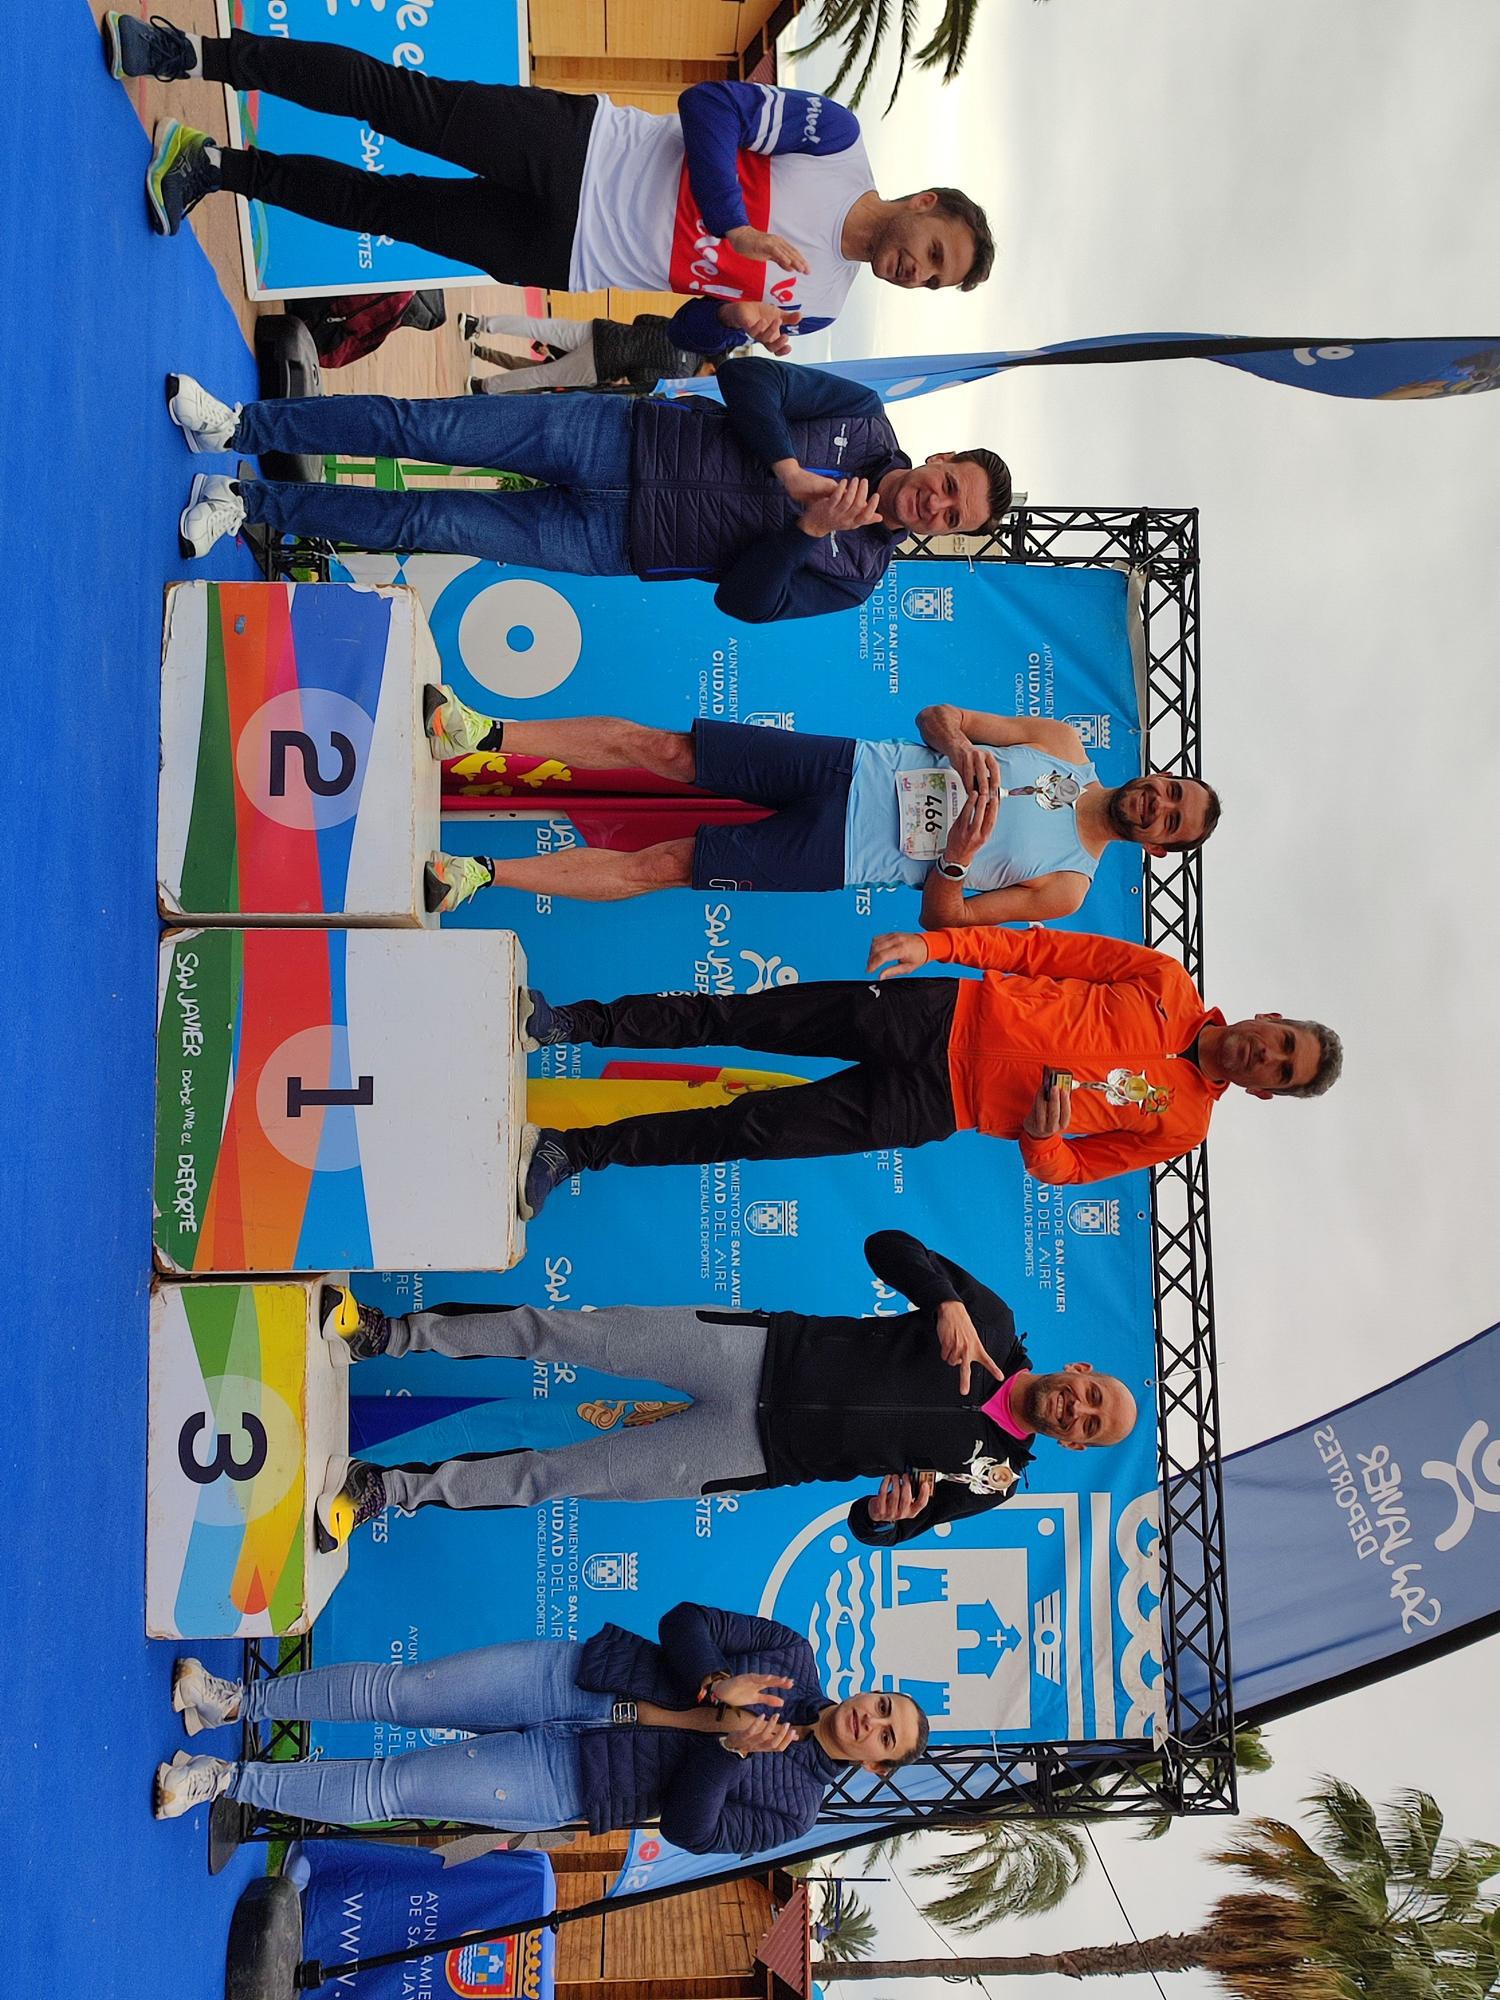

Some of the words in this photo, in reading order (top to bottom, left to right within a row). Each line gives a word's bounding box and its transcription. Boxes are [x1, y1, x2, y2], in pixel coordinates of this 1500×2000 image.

[872, 595, 884, 625] DEL
[888, 605, 898, 620] DE
[859, 614, 869, 660] DEPORTES
[873, 631, 885, 672] AIRE
[889, 623, 898, 648] SAN
[712, 650, 724, 715] CIUDAD
[889, 651, 899, 694] JAVIER
[1042, 642, 1054, 720] AYUNTAMIENT
[1014, 672, 1024, 717] CONCEJAL
[269, 730, 357, 797] 2
[924, 795, 943, 833] 466
[704, 903, 731, 947] SAN
[174, 952, 200, 990] SAN
[706, 949, 736, 997] JAVI
[176, 990, 203, 1057] JAVIER
[286, 1075, 374, 1118] 1
[700, 1164, 710, 1214] ONCEJALÍA
[893, 1150, 904, 1194] JAVIER
[172, 1153, 198, 1235] DEPORTE
[700, 1216, 709, 1229] DE
[714, 1210, 726, 1242] DEL
[730, 1221, 741, 1237] DE
[1024, 1215, 1033, 1228] DE
[1037, 1209, 1050, 1241] DEL
[1054, 1220, 1064, 1236] DE
[700, 1231, 710, 1279] DEPORTES
[714, 1248, 727, 1292] AIRE
[730, 1240, 741, 1267] SAN
[1024, 1229, 1034, 1278] DEPORTES
[1039, 1247, 1051, 1290] AIRE
[1055, 1239, 1065, 1265] SAN
[413, 1273, 423, 1313] JAVIE
[544, 1256, 572, 1302] SAN
[731, 1269, 741, 1307] JAVIE
[1055, 1267, 1066, 1313] JAVIER
[178, 1411, 268, 1485] 3
[536, 1508, 548, 1569] CONCEJALÍA
[551, 1500, 564, 1558] IUDAD
[568, 1497, 579, 1572] NTAMIENTO
[536, 1571, 546, 1585] DE
[550, 1563, 564, 1598] DEL
[568, 1575, 578, 1592] DE
[536, 1586, 547, 1636] DEPORTES
[551, 1604, 564, 1638] AIR
[568, 1595, 578, 1623] SAN
[374, 1726, 383, 1740] DE
[406, 1731, 415, 1749] DE
[409, 1895, 423, 1917] DE
[418, 1891, 439, 2000] AYUNAMIE
